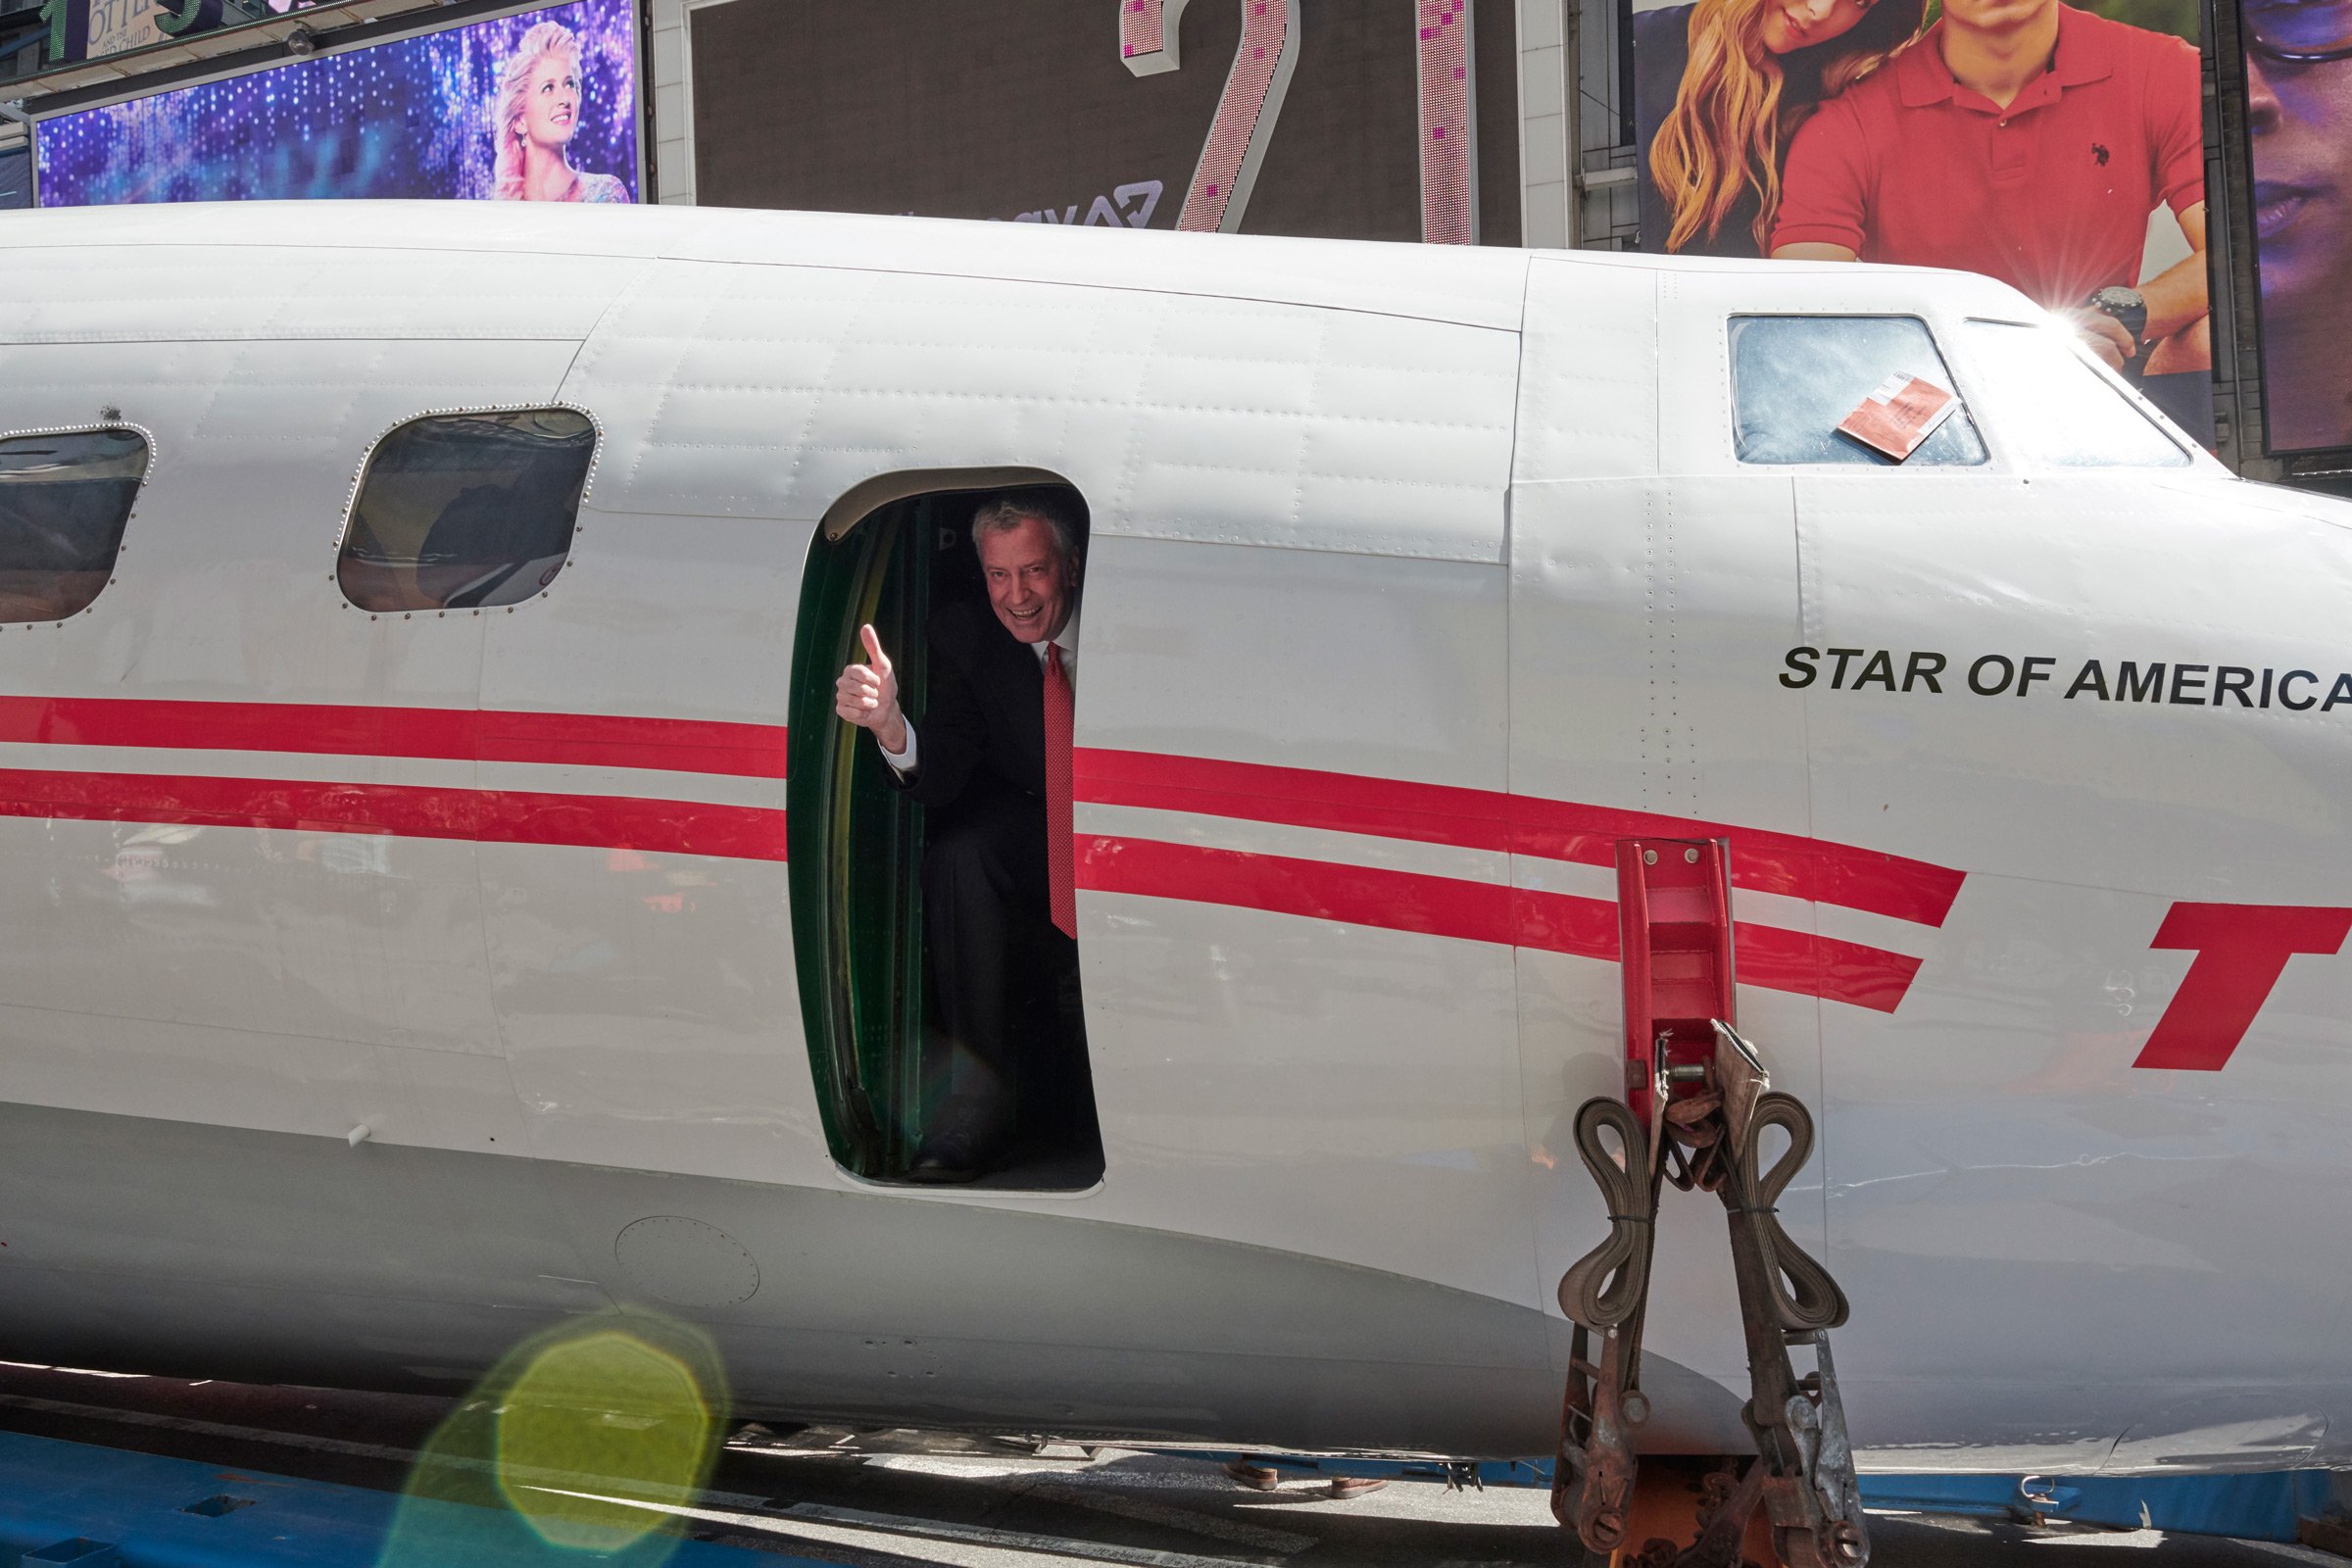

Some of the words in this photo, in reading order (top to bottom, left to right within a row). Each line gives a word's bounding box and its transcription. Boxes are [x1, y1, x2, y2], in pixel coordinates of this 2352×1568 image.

[1779, 647, 1947, 694] STAR
[1967, 655, 2057, 697] OF
[2064, 660, 2352, 712] AMERICA
